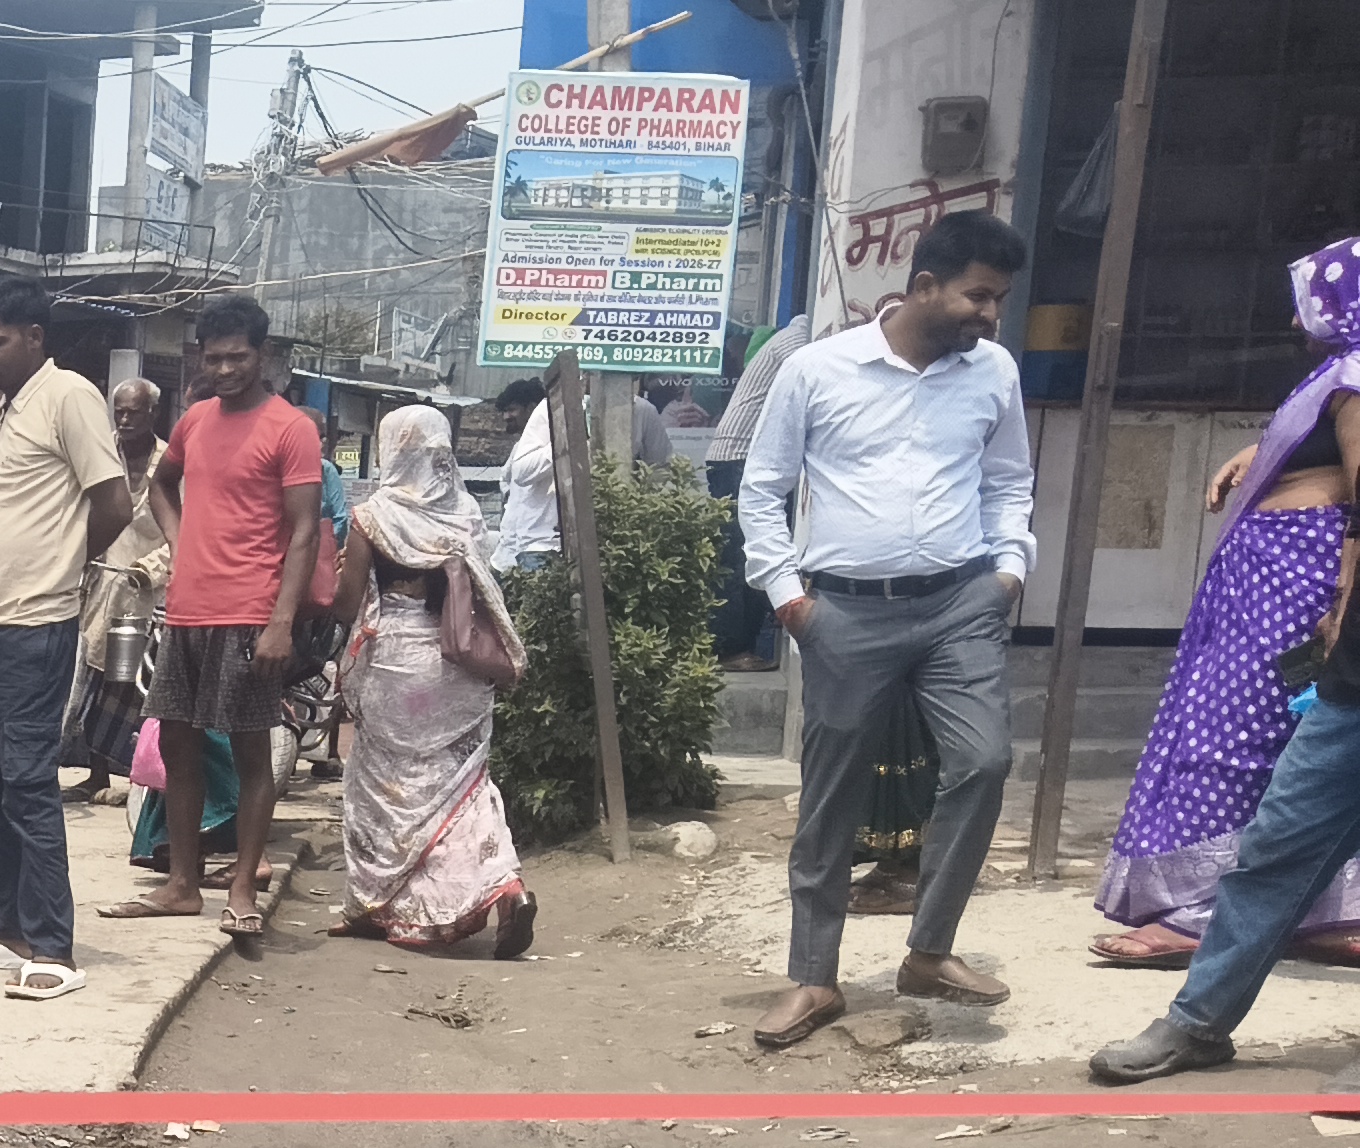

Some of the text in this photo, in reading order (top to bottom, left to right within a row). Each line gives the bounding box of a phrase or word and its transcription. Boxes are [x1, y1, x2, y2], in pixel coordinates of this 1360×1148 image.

[543, 83, 742, 114] CHAMPARAN
[518, 113, 742, 140] COLLEGE OF PHARMACY
[515, 136, 576, 149] GULARIYA,
[579, 138, 637, 150] MOTIHARI
[647, 140, 691, 153] 845401,
[694, 141, 732, 152] BIHAR
[501, 253, 562, 265] Admission
[565, 255, 596, 268] Open
[599, 254, 616, 266] for
[619, 256, 665, 268] Session
[499, 268, 721, 291] D.Pharm B.Pharm
[501, 308, 714, 327] Director TABREZ AHMAD
[581, 328, 710, 344] 7462042892
[612, 347, 714, 364] 8092821117
[658, 378, 692, 387] vivo
